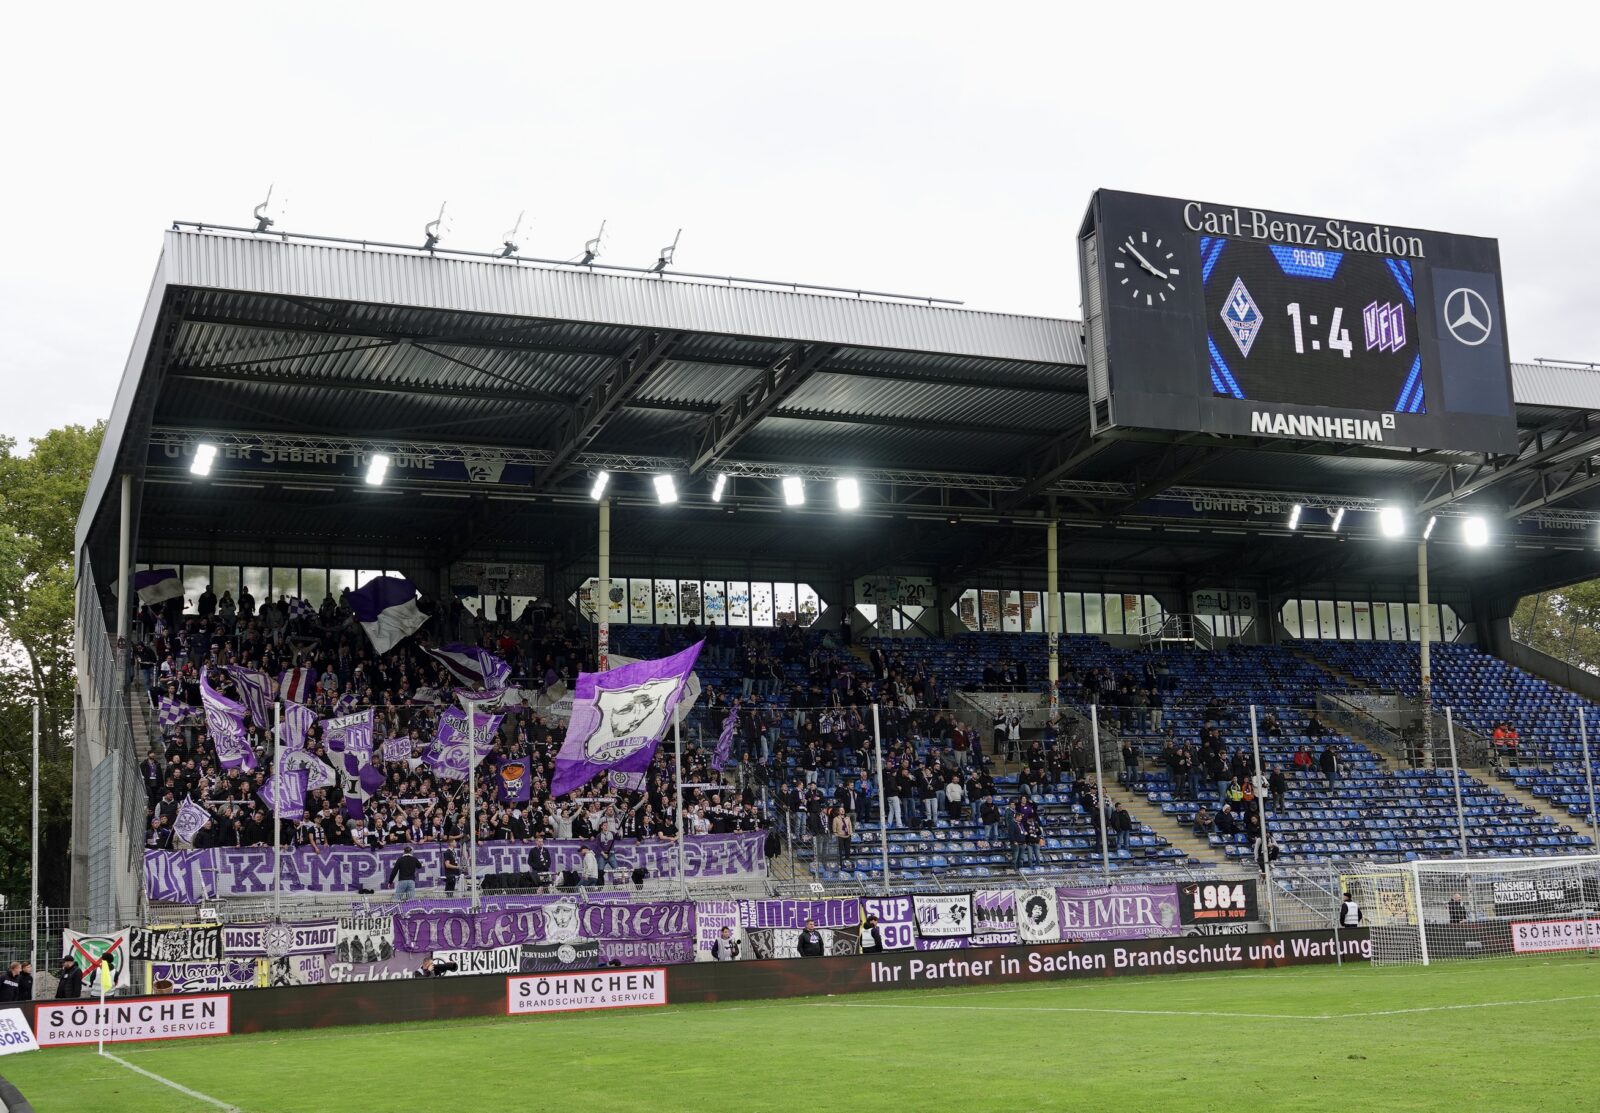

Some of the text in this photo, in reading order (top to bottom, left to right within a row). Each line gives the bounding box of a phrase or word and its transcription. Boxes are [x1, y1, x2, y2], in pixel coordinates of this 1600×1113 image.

[1183, 201, 1425, 258] Carl-Benz-Stadion
[1293, 249, 1325, 268] 90:00
[1286, 302, 1353, 358] 1:4
[1251, 411, 1383, 441] MANNHEIM
[229, 846, 474, 893] KÄMPFE
[812, 883, 823, 892] 26
[1493, 880, 1534, 891] SINSHEIM
[1494, 890, 1564, 902] WALDHOF TREU!
[697, 901, 737, 914] ULTRAS
[1193, 884, 1246, 910] 1984
[202, 909, 214, 918] 27
[740, 901, 749, 928] ULTRA
[866, 899, 909, 922] SUP
[1062, 896, 1157, 928] EIMER
[400, 903, 691, 952] VIOLET CREW
[698, 916, 736, 928] PASSION
[225, 927, 336, 948] HASE STADT
[702, 928, 734, 939] BEFOE
[884, 925, 912, 947] 90
[576, 948, 598, 958] GUYS
[871, 937, 1371, 983] Ihr Partner in Sachen Brandschutz und Wartung
[519, 973, 655, 997] SÖHNCHEN
[519, 992, 655, 1008] BRANDSCHUTZ & SERVICE
[50, 1000, 216, 1028] SÖHNCHEN
[49, 1020, 216, 1040] BRANDSCHUTZ & SERVICE
